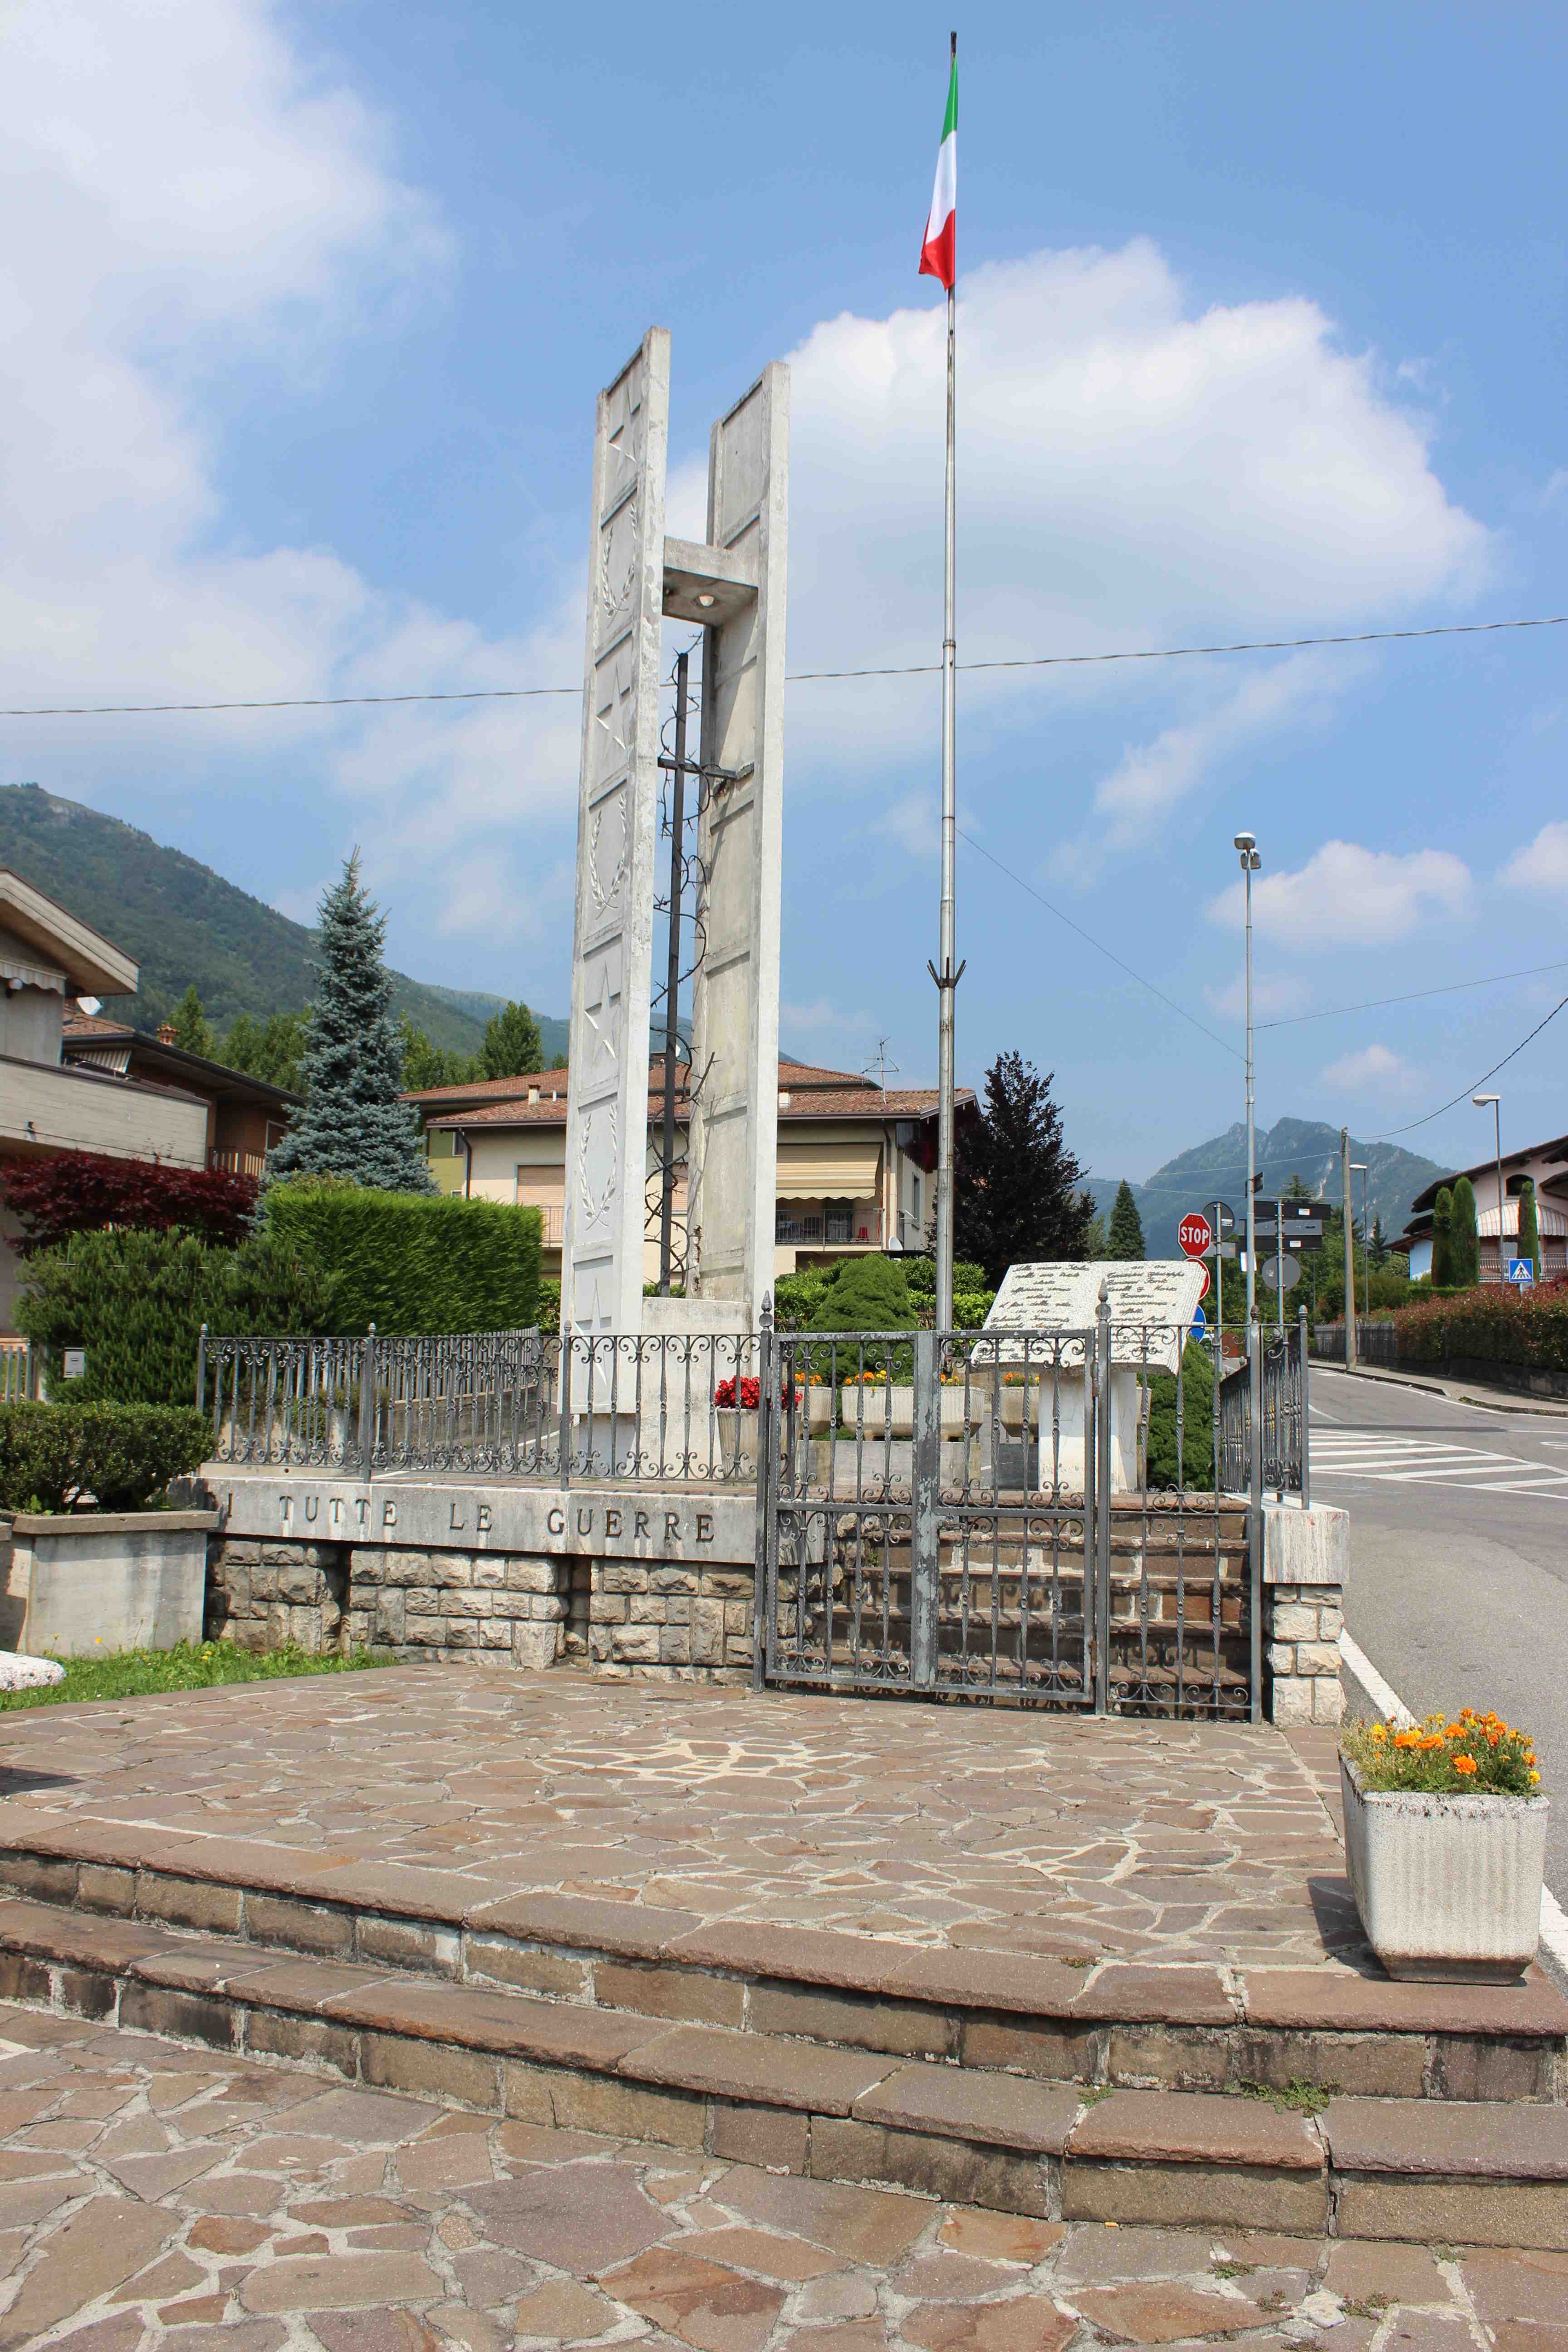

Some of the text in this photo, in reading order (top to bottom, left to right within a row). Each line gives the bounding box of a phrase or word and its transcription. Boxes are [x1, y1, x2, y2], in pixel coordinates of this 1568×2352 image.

[1181, 1226, 1209, 1245] STOP
[279, 1496, 398, 1526] TUTTE
[450, 1503, 493, 1532] LE
[547, 1508, 715, 1543] GUERRE
